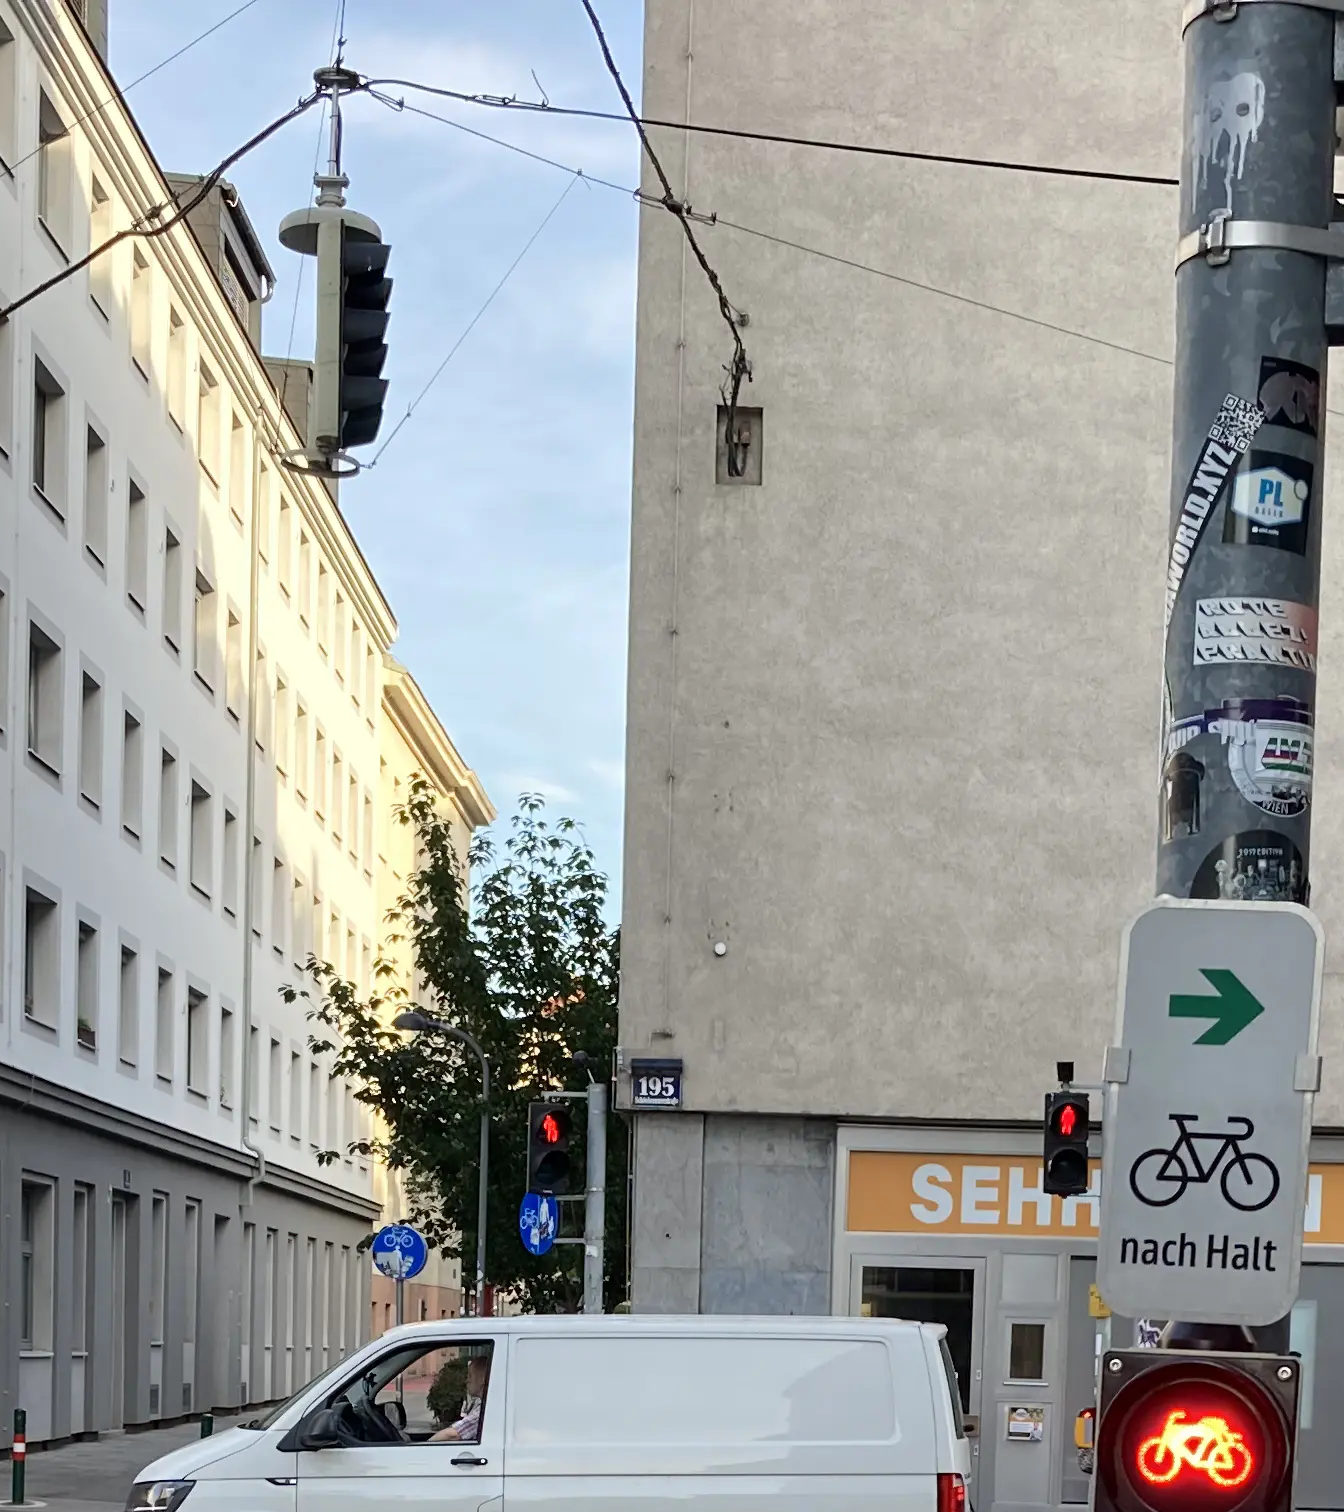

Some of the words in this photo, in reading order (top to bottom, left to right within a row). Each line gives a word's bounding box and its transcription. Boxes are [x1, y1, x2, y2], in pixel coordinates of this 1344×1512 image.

[1258, 478, 1284, 507] PL
[1262, 800, 1289, 815] WIEN
[638, 1076, 675, 1096] 195
[1120, 1232, 1197, 1268] nach
[1206, 1234, 1278, 1272] Halt
